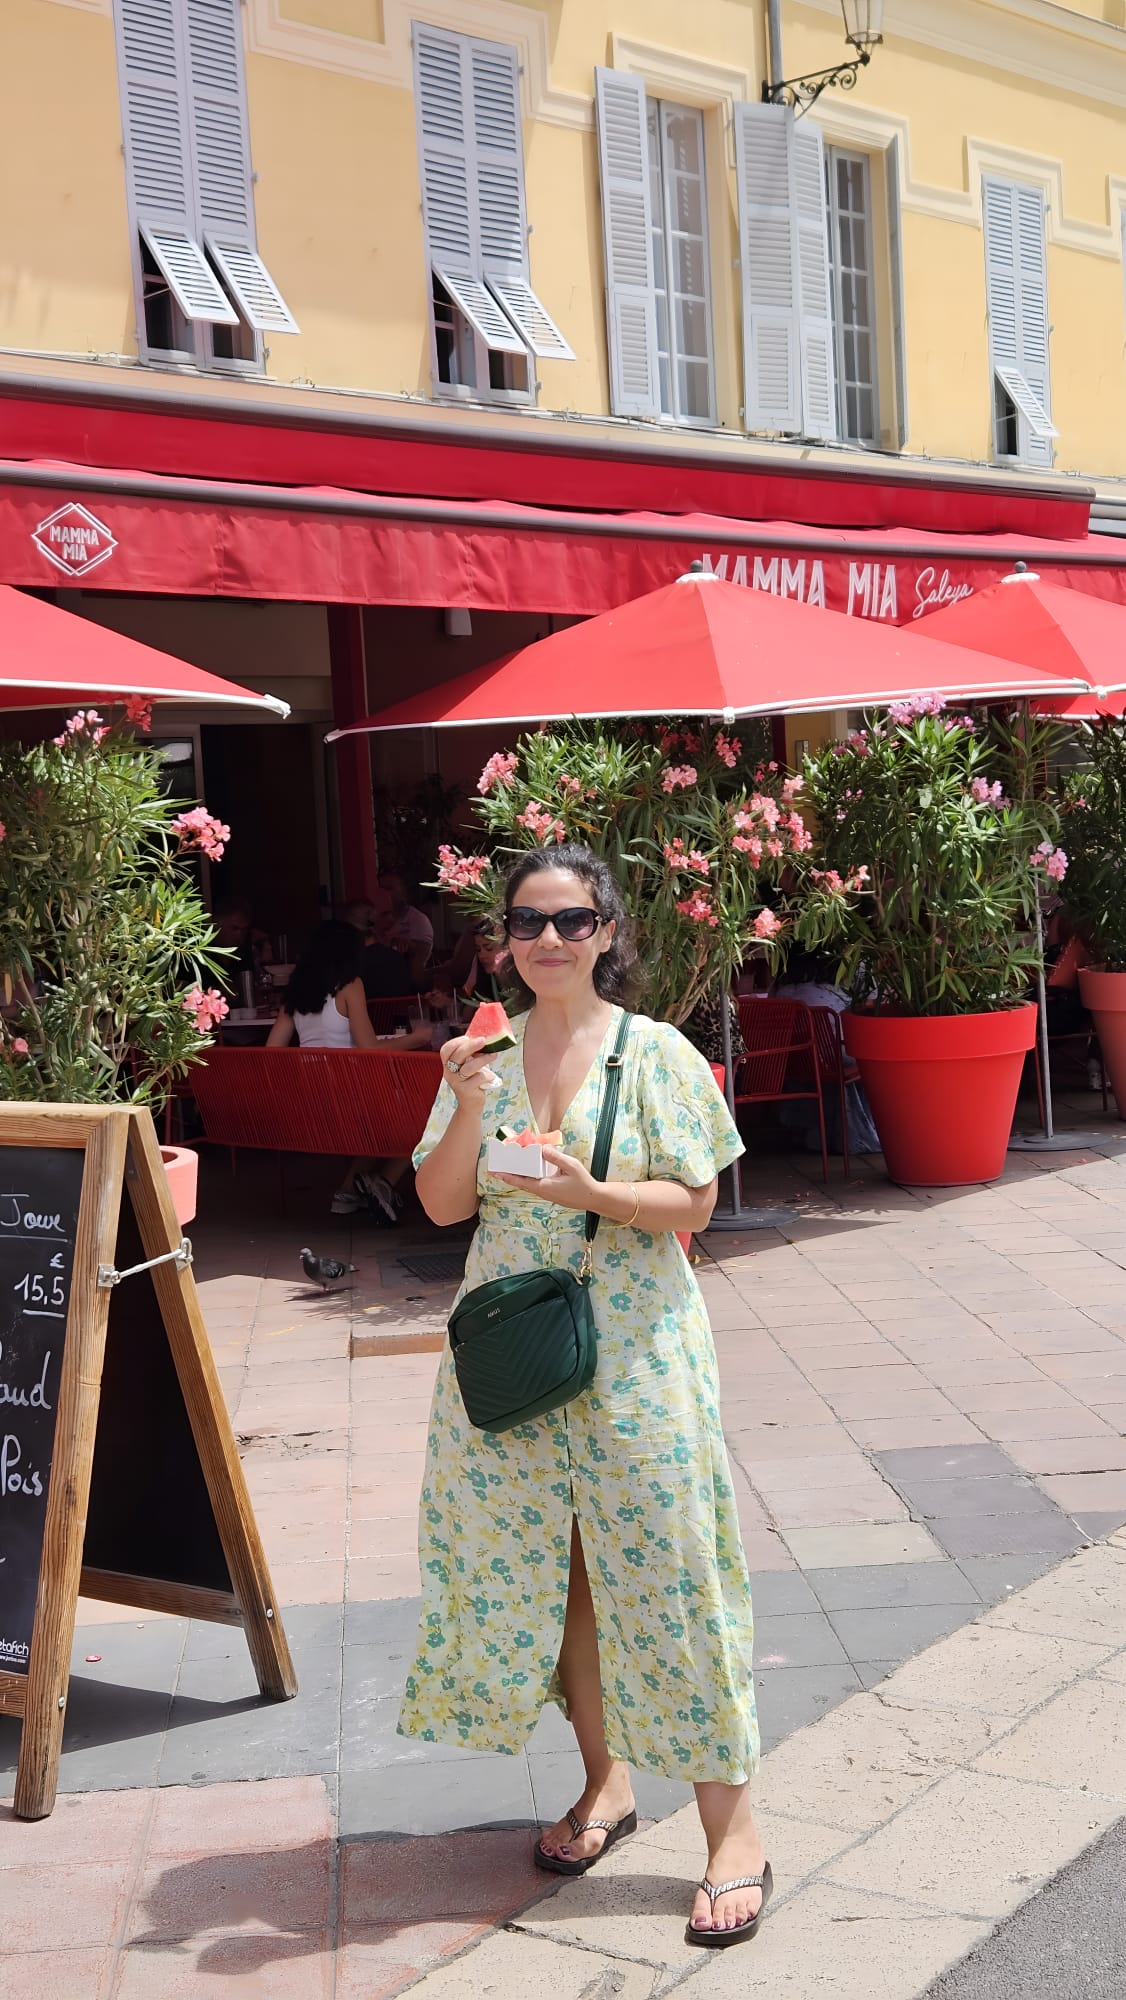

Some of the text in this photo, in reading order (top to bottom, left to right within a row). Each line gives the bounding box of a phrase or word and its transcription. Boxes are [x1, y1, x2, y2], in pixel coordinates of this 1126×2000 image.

[50, 525, 99, 546] MAMMA
[63, 543, 87, 561] MIA
[847, 562, 898, 618] MIA
[912, 566, 974, 619] Saleya
[14, 1273, 65, 1305] 15,5
[1, 1434, 43, 1497] Pois
